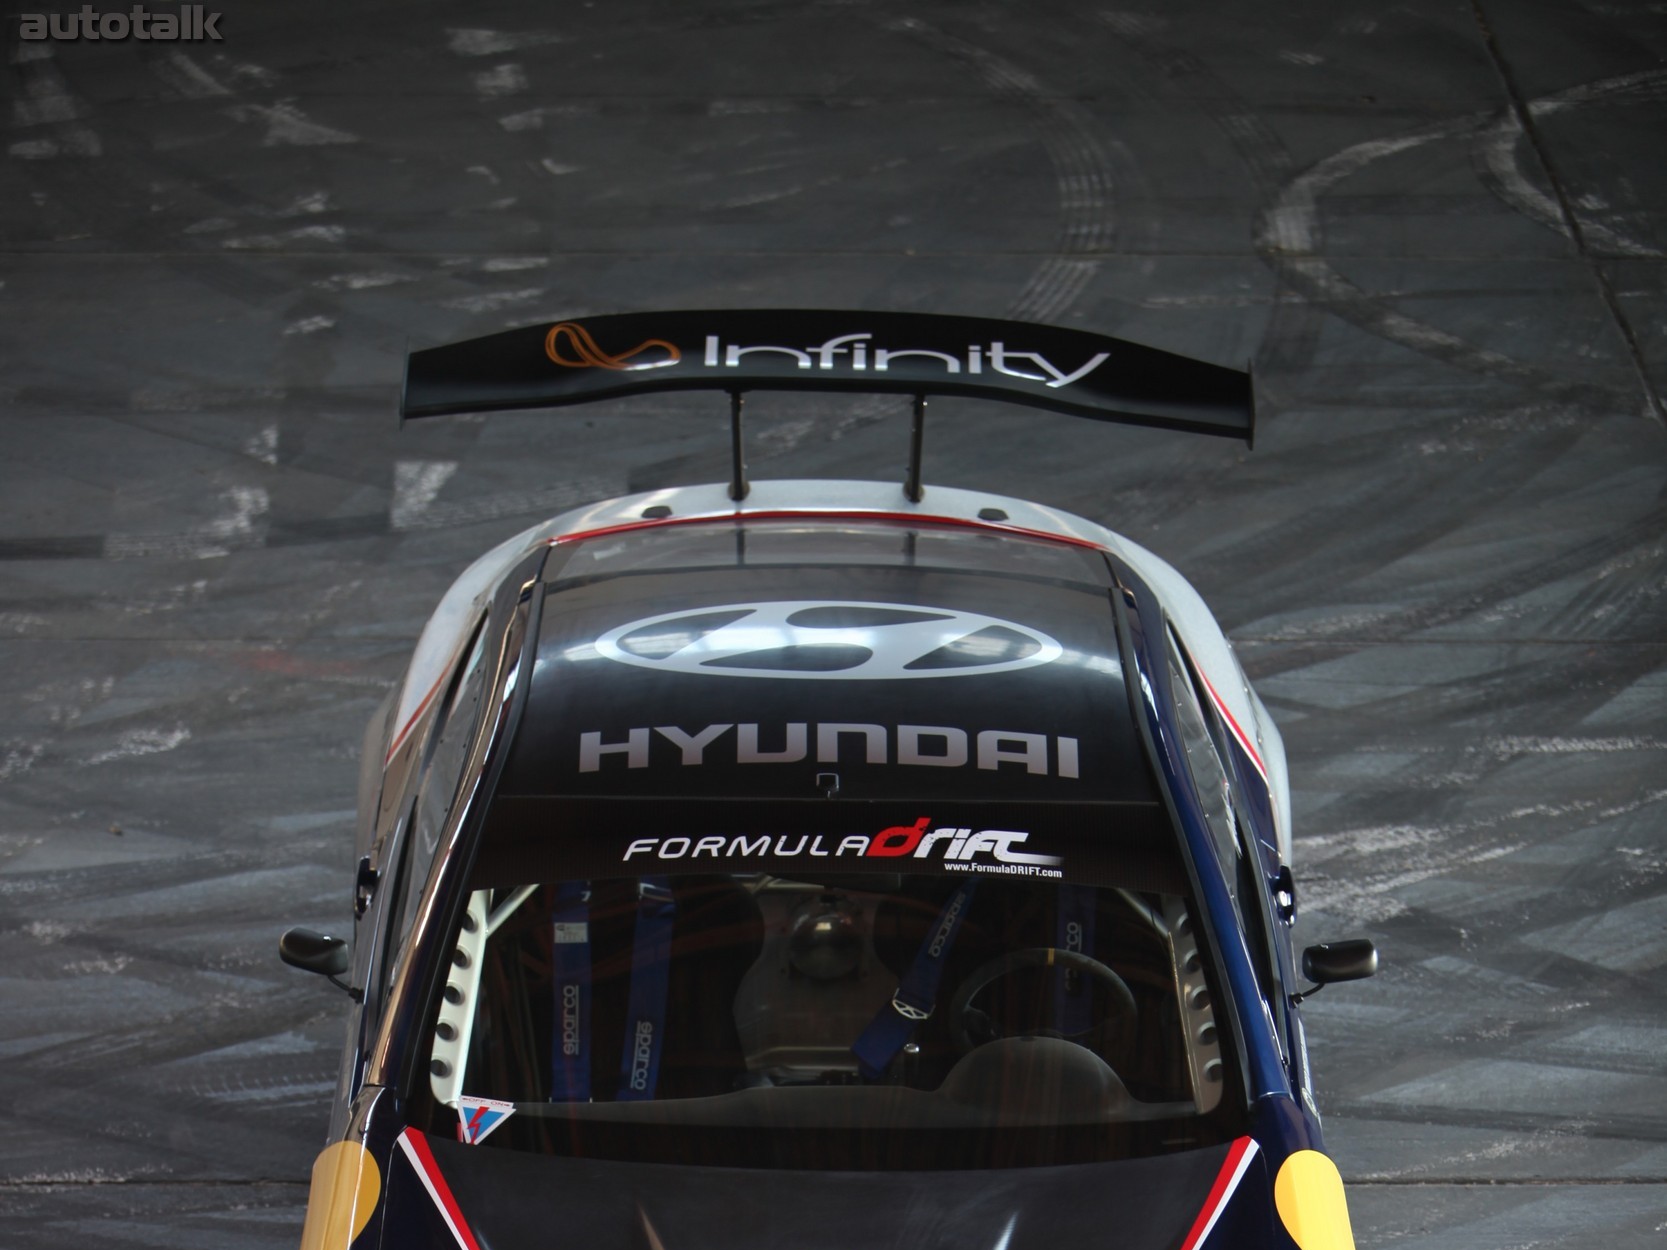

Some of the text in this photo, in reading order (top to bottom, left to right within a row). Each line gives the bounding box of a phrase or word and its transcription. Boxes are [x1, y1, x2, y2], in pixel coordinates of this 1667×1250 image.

[705, 333, 1113, 387] Infinity
[579, 722, 1080, 779] HYUNDAI
[622, 834, 868, 862] FORMULA
[944, 861, 1063, 878] www.FormulaDRIFT.com
[563, 985, 580, 1055] sparco
[630, 1020, 653, 1091] sparco
